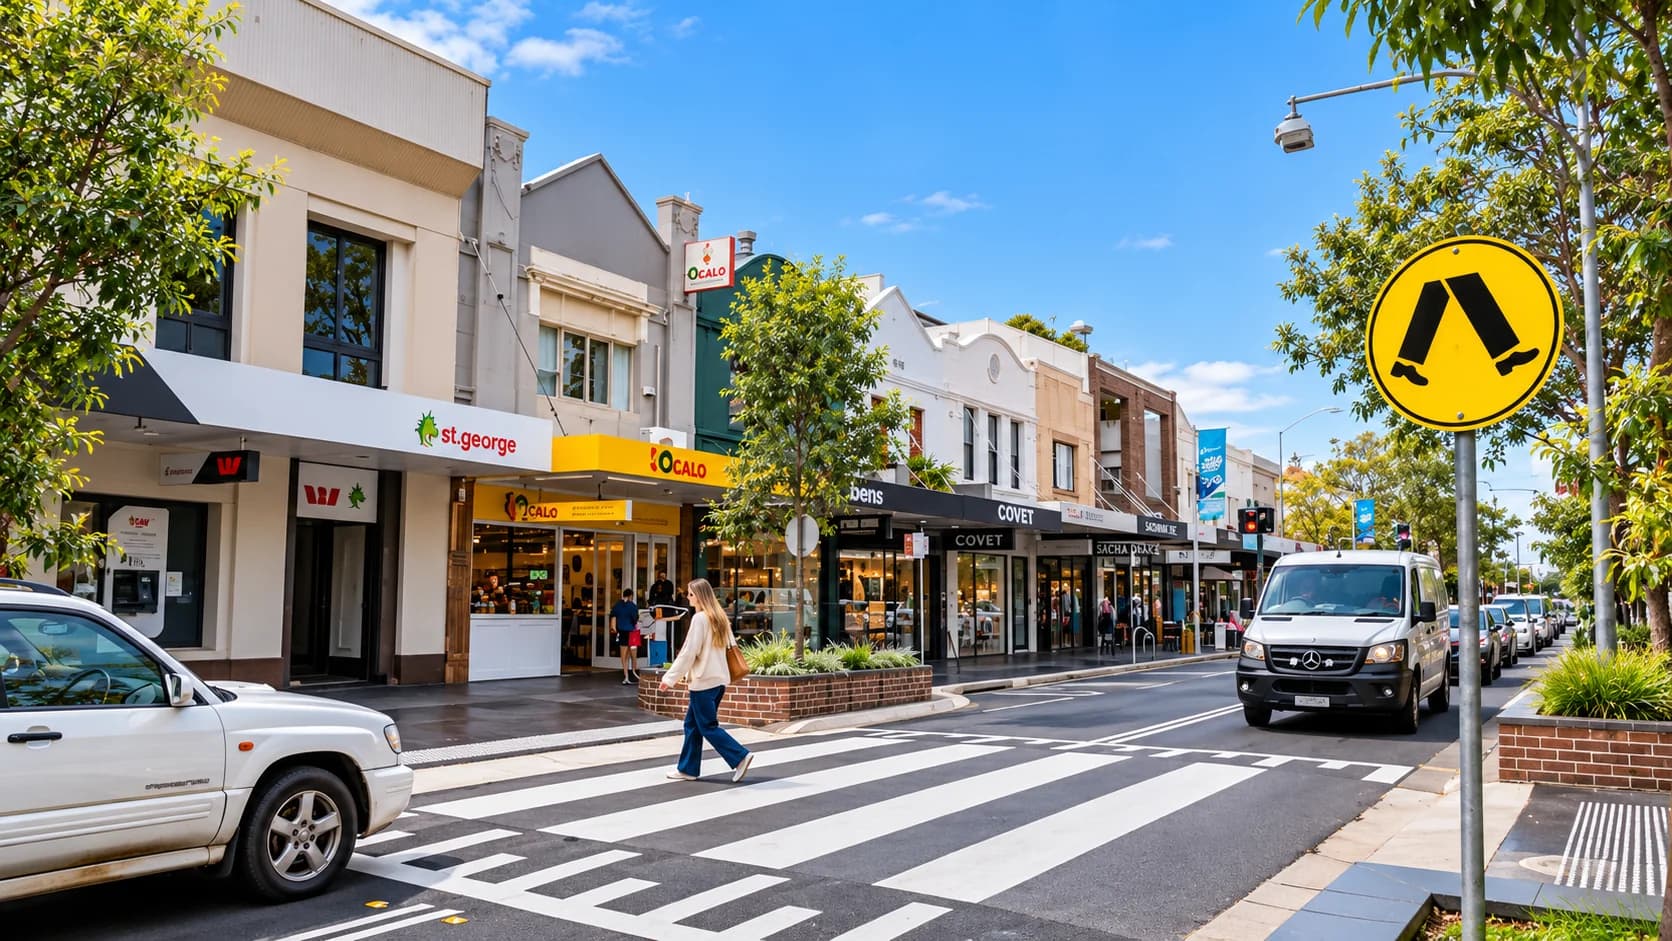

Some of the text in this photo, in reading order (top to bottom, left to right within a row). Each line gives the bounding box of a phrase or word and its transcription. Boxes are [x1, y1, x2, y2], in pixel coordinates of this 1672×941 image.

[687, 266, 726, 280] OCALO
[441, 426, 516, 456] st.george
[998, 504, 1034, 525] COVET
[955, 534, 1004, 547] COVET
[1096, 544, 1128, 555] SACHA
